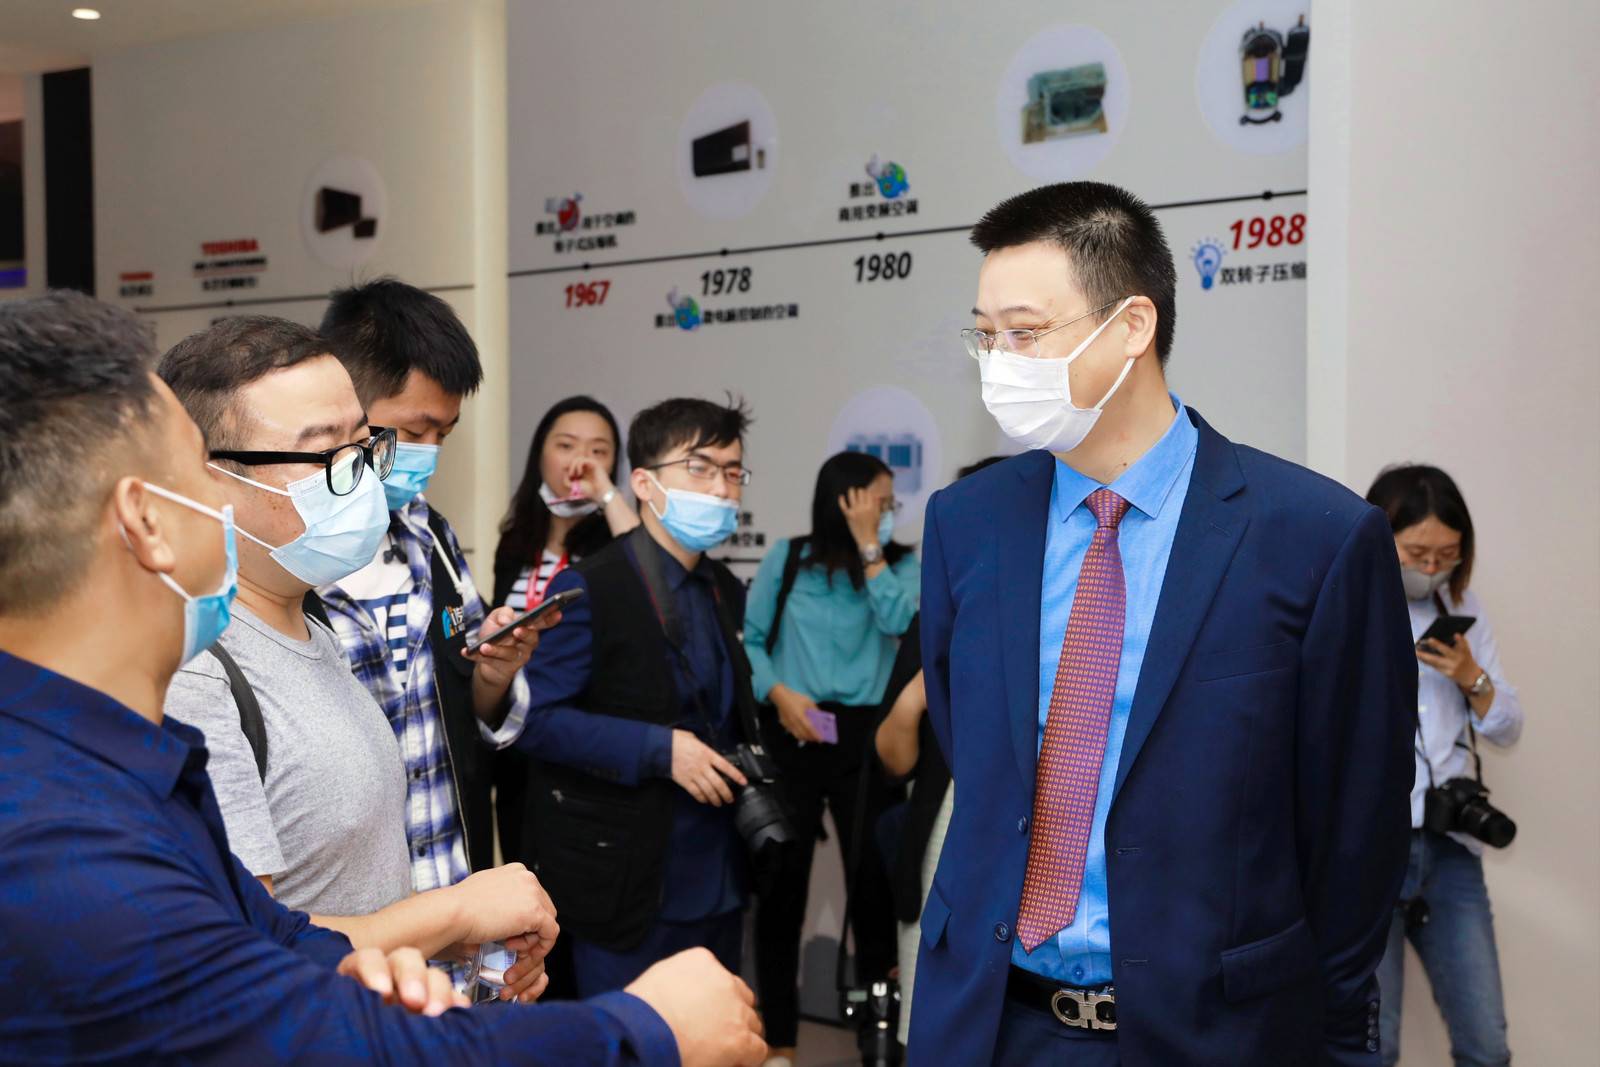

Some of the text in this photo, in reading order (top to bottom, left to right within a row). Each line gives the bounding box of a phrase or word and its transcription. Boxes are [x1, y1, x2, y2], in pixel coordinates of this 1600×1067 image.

[1229, 212, 1307, 251] 1988
[700, 267, 752, 296] 1978
[853, 251, 912, 283] 1980
[564, 280, 611, 308] 1967
